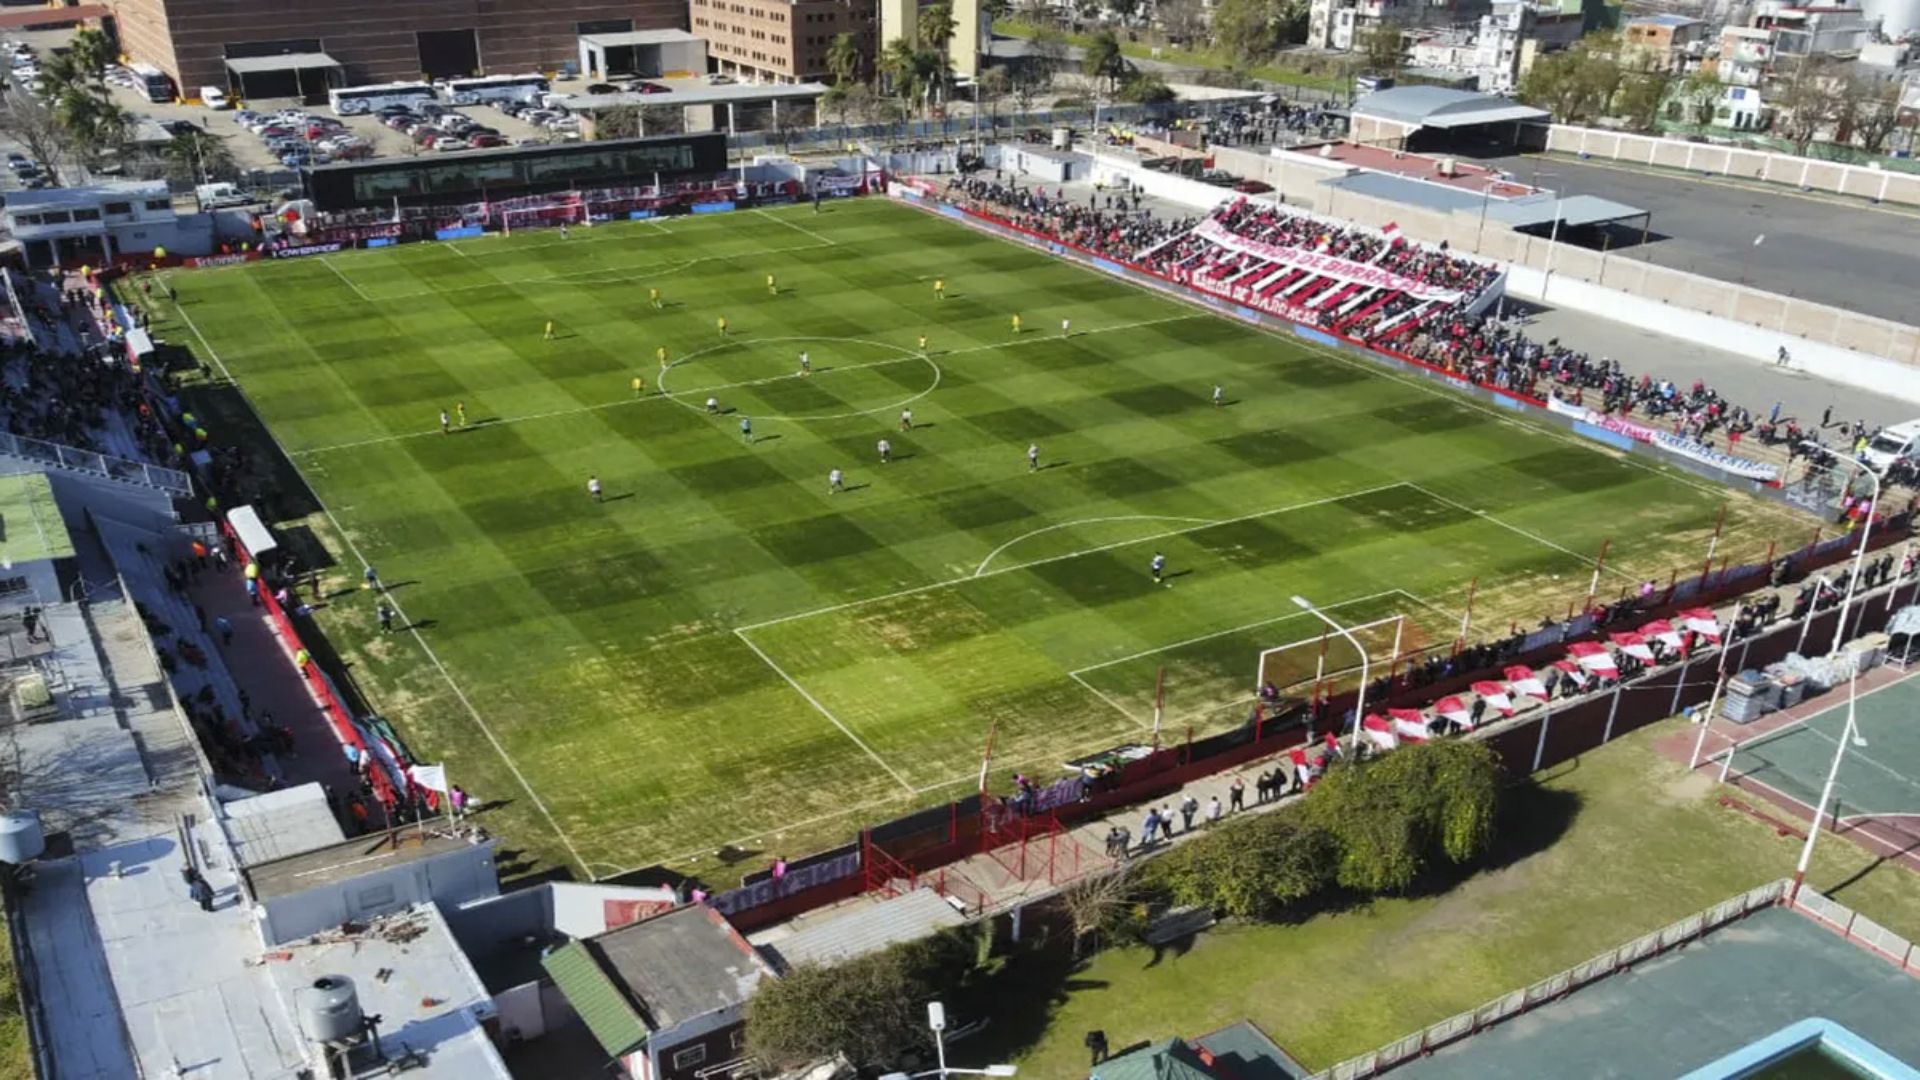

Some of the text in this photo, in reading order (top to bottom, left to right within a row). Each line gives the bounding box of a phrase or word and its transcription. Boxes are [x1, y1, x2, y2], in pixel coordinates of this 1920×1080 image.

[1297, 253, 1325, 267] DE
[1172, 267, 1188, 284] LA
[1192, 270, 1231, 297] BANDA
[1232, 285, 1249, 302] DE
